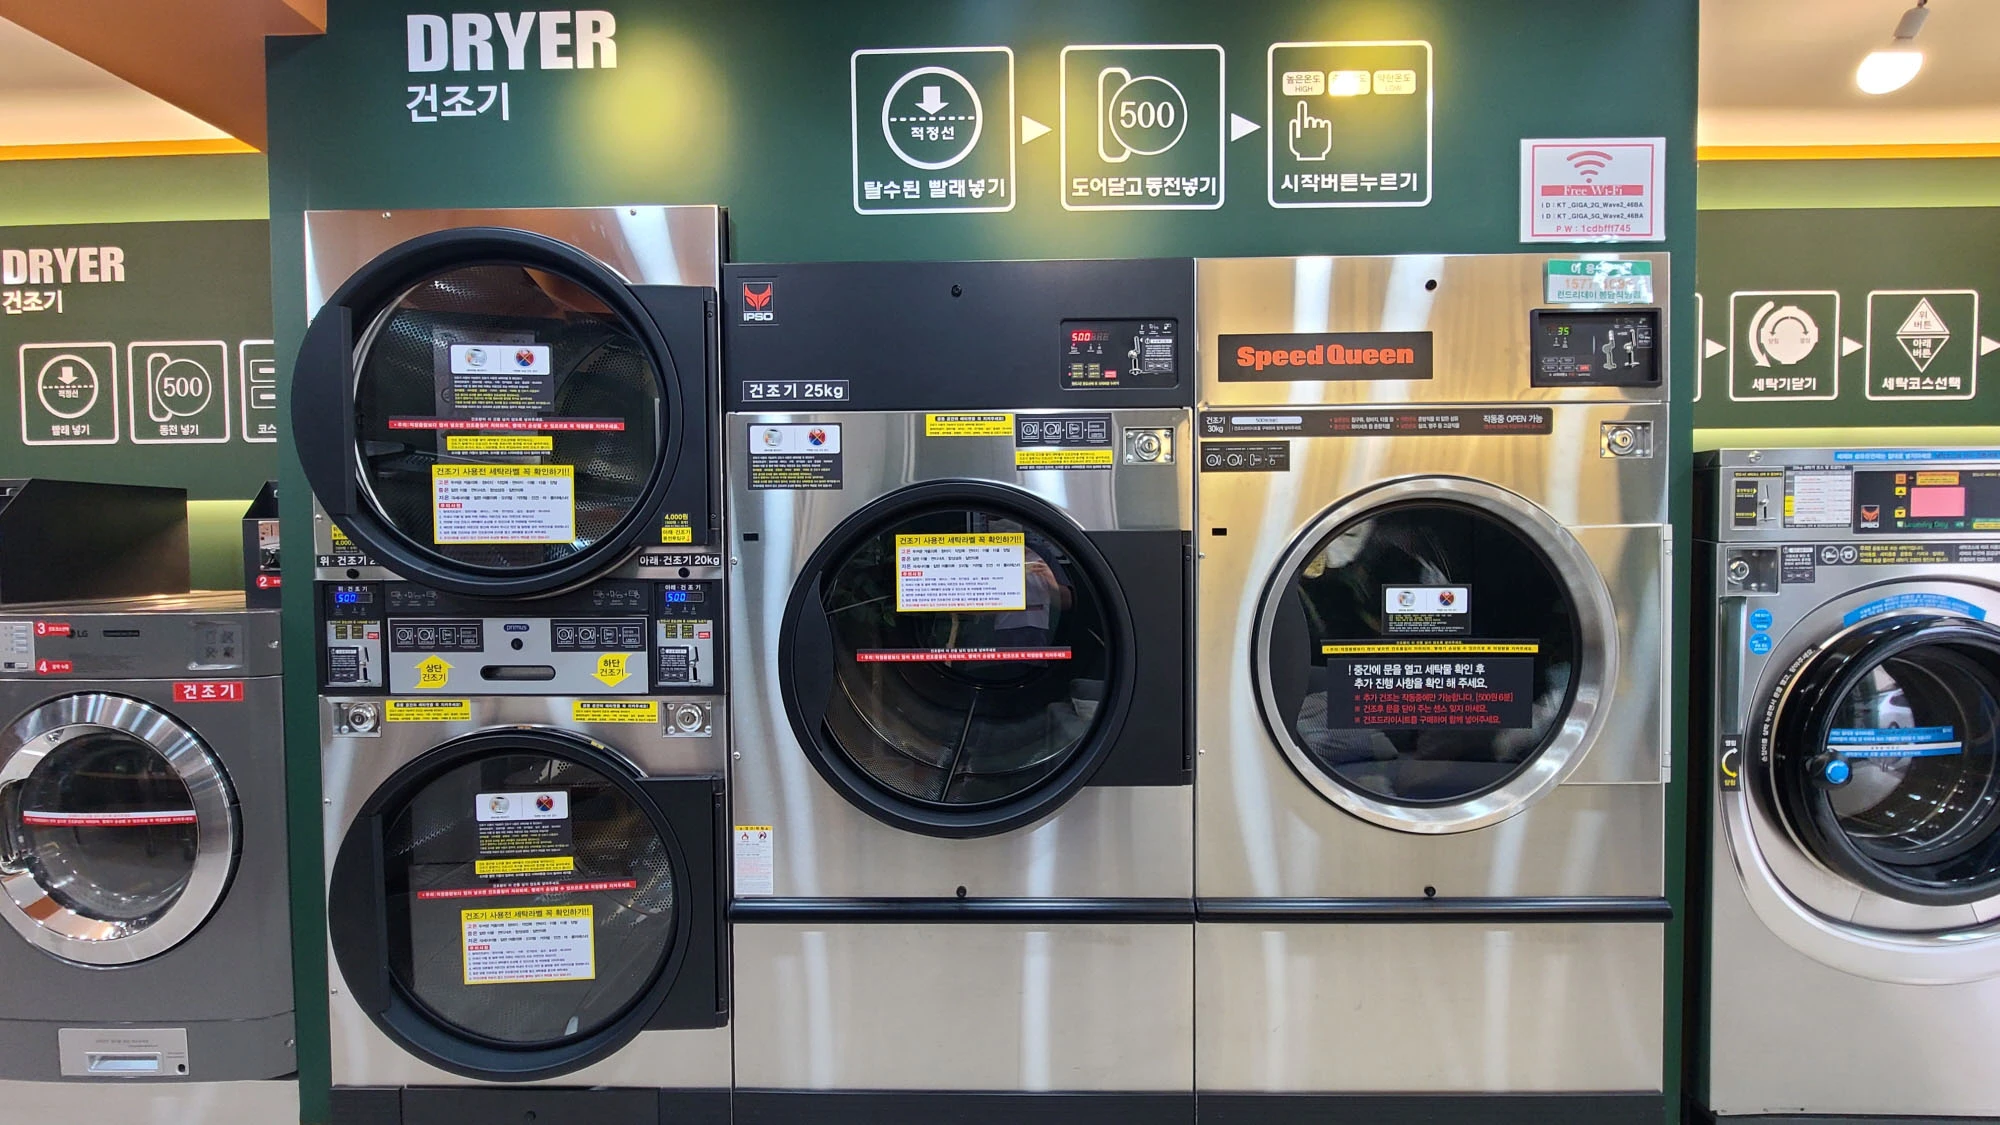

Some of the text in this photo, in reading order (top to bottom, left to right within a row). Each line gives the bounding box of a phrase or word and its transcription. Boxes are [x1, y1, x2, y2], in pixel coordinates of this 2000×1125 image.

[406, 10, 617, 72] DRYER
[1286, 74, 1321, 84] 높은온도
[406, 82, 509, 122] 건조기
[1119, 101, 1175, 129] 500
[911, 126, 955, 141] 적정선
[1281, 172, 1418, 193] 시작버튼누르기
[864, 178, 1005, 199] 탈수된 빨래넣기
[1563, 185, 1623, 196] Free Wi-Fi
[2, 247, 125, 285] DRYER
[2, 290, 63, 314] 건조기
[743, 312, 773, 321] IPSO
[1919, 310, 1928, 319] 위
[1913, 320, 1932, 329] 버튼
[1558, 327, 1569, 336] 35
[1913, 338, 1932, 348] 아래
[1237, 344, 1414, 371] Speed Queen
[1913, 349, 1932, 358] 버튼
[164, 377, 202, 397] 500
[1752, 378, 1817, 391] 세탁기닫기
[1882, 377, 1961, 390] 세탁코스선택
[749, 383, 843, 399] 건조기 25kg
[1506, 414, 1527, 422] OPEN
[51, 424, 90, 436] 빨래 넣기
[159, 424, 199, 436] 동전 넣기
[1207, 425, 1224, 433] 30kg
[900, 536, 920, 544] 건조기
[924, 536, 944, 544] 사용전
[695, 555, 719, 565] 20kg
[260, 577, 267, 586] 2
[38, 623, 45, 634] 3
[40, 661, 47, 672] 4
[426, 664, 442, 672] 상단
[603, 659, 620, 667] 하단
[600, 668, 624, 676] 건조기
[1354, 664, 1381, 676] 중간에
[1384, 664, 1402, 676] 문을
[1404, 664, 1422, 676] 열고
[1425, 664, 1452, 676] 세탁물
[1455, 664, 1473, 675] 확인
[1475, 664, 1485, 675] 후
[423, 673, 446, 681] 건조기
[1354, 677, 1488, 689] 추가 진행 사항을 확인 해 주세요.
[184, 684, 234, 699] 건조기
